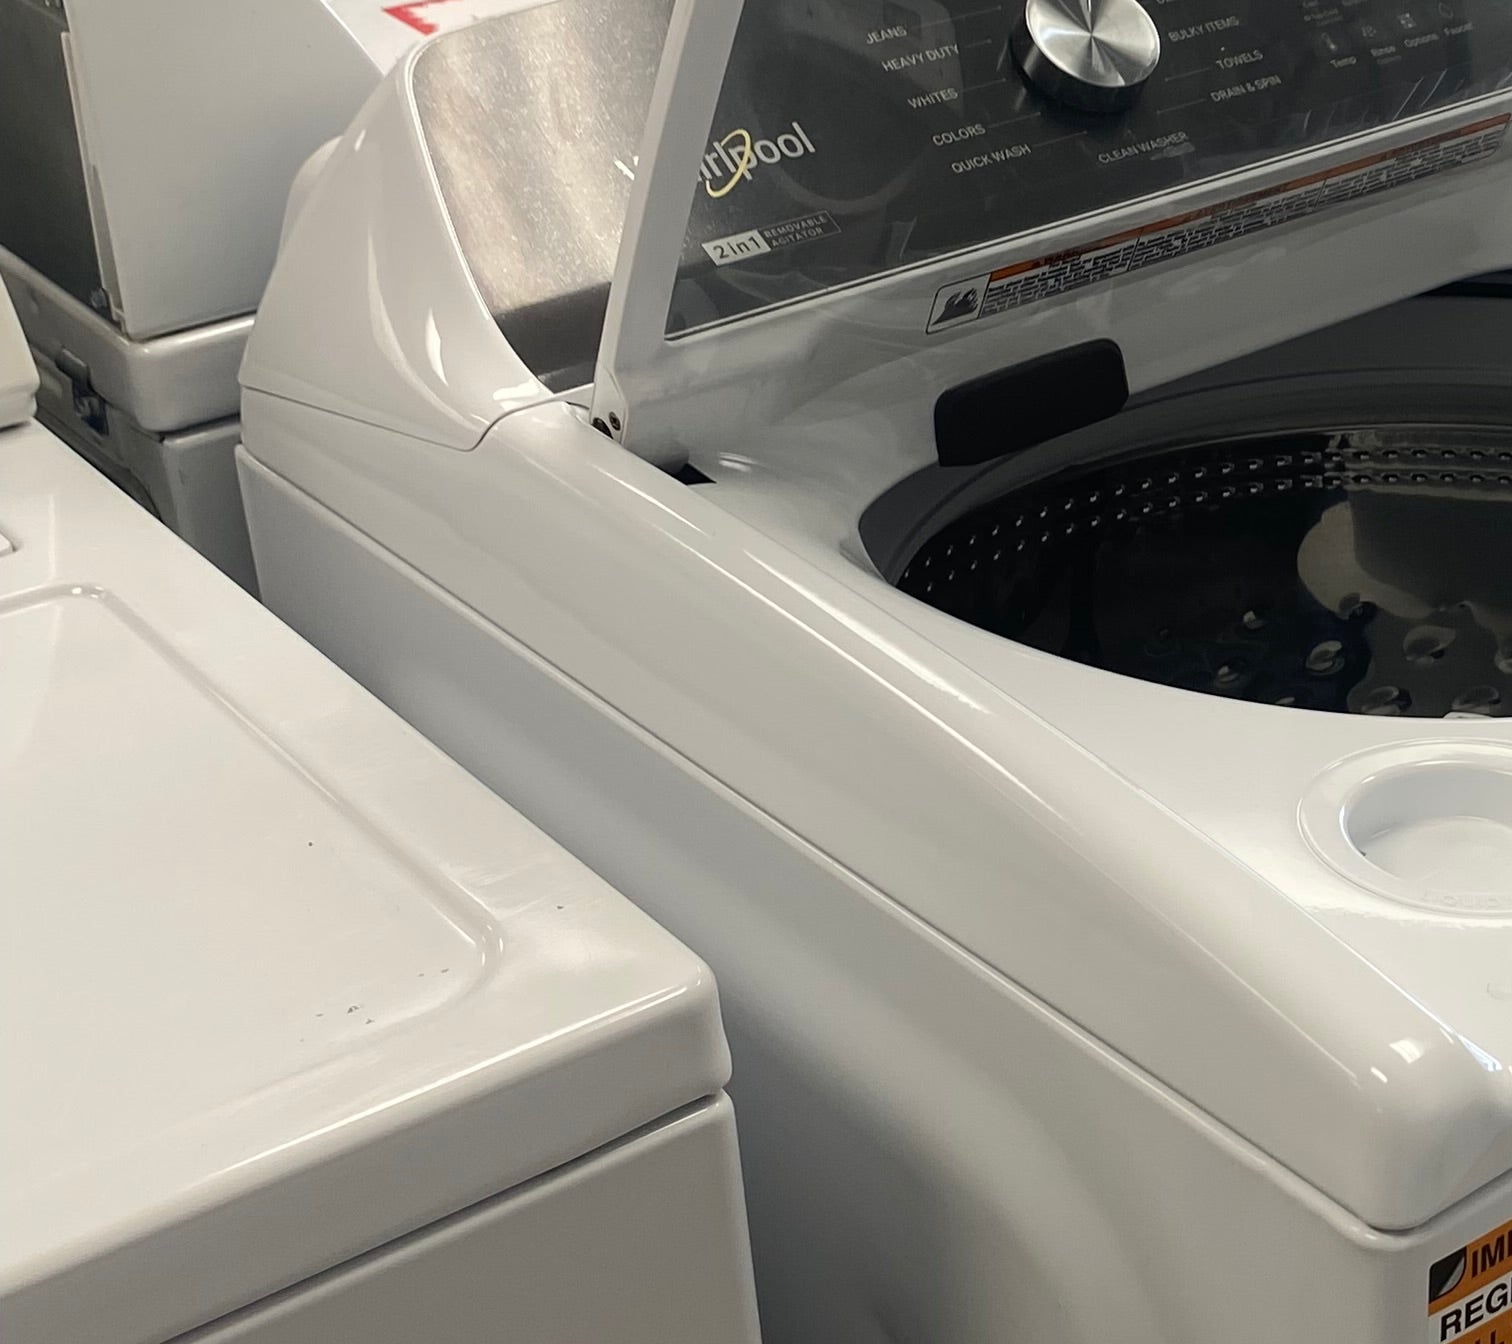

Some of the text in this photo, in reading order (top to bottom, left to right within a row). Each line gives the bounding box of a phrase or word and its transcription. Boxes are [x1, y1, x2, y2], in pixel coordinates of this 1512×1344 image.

[865, 26, 907, 44] JEANS
[1168, 16, 1240, 42] BULKY ITEMS
[881, 44, 959, 72] HEAVY DUTY
[1216, 50, 1264, 70] TOWELS
[907, 87, 958, 109] WHITES
[1211, 83, 1246, 102] DRAIN
[1255, 74, 1282, 91] SPIN
[932, 124, 986, 146] COLORS
[951, 144, 1031, 173] QUICK WASH
[1098, 131, 1190, 164] CLEAN WASHER
[763, 215, 827, 238] REMOVABLE
[771, 227, 823, 247] AGITATOR
